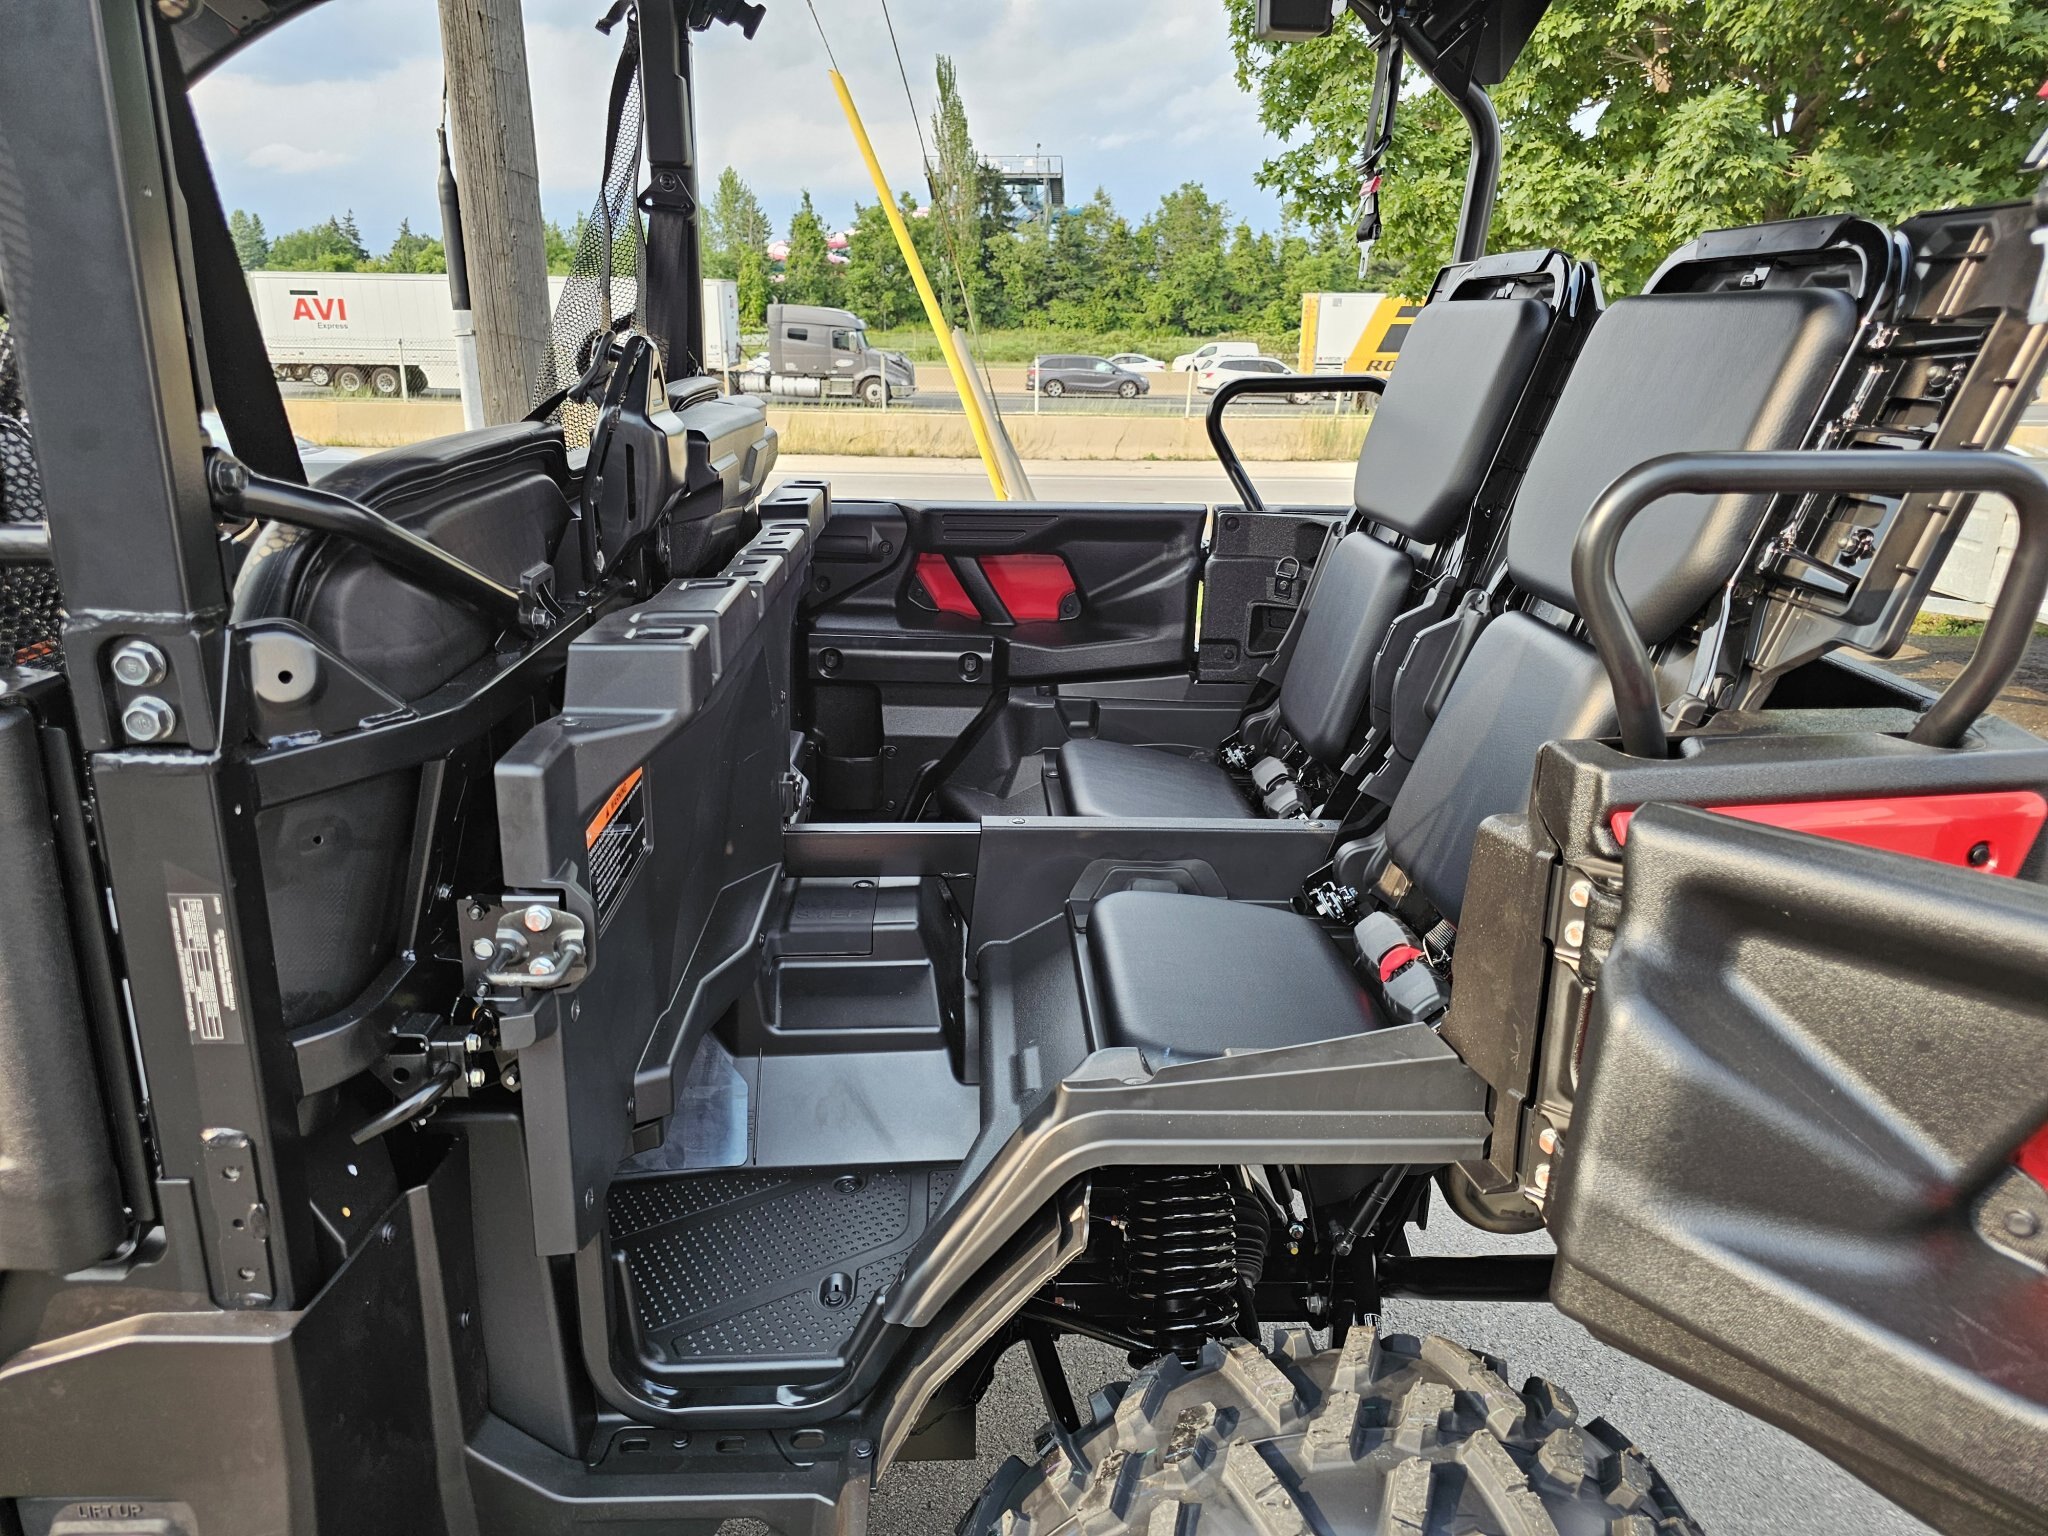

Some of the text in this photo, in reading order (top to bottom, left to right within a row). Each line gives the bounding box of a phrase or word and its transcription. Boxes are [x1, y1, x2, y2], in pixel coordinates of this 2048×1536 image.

[293, 297, 347, 321] AVI
[317, 321, 349, 330] Express
[78, 1504, 144, 1518] LIFT UP
